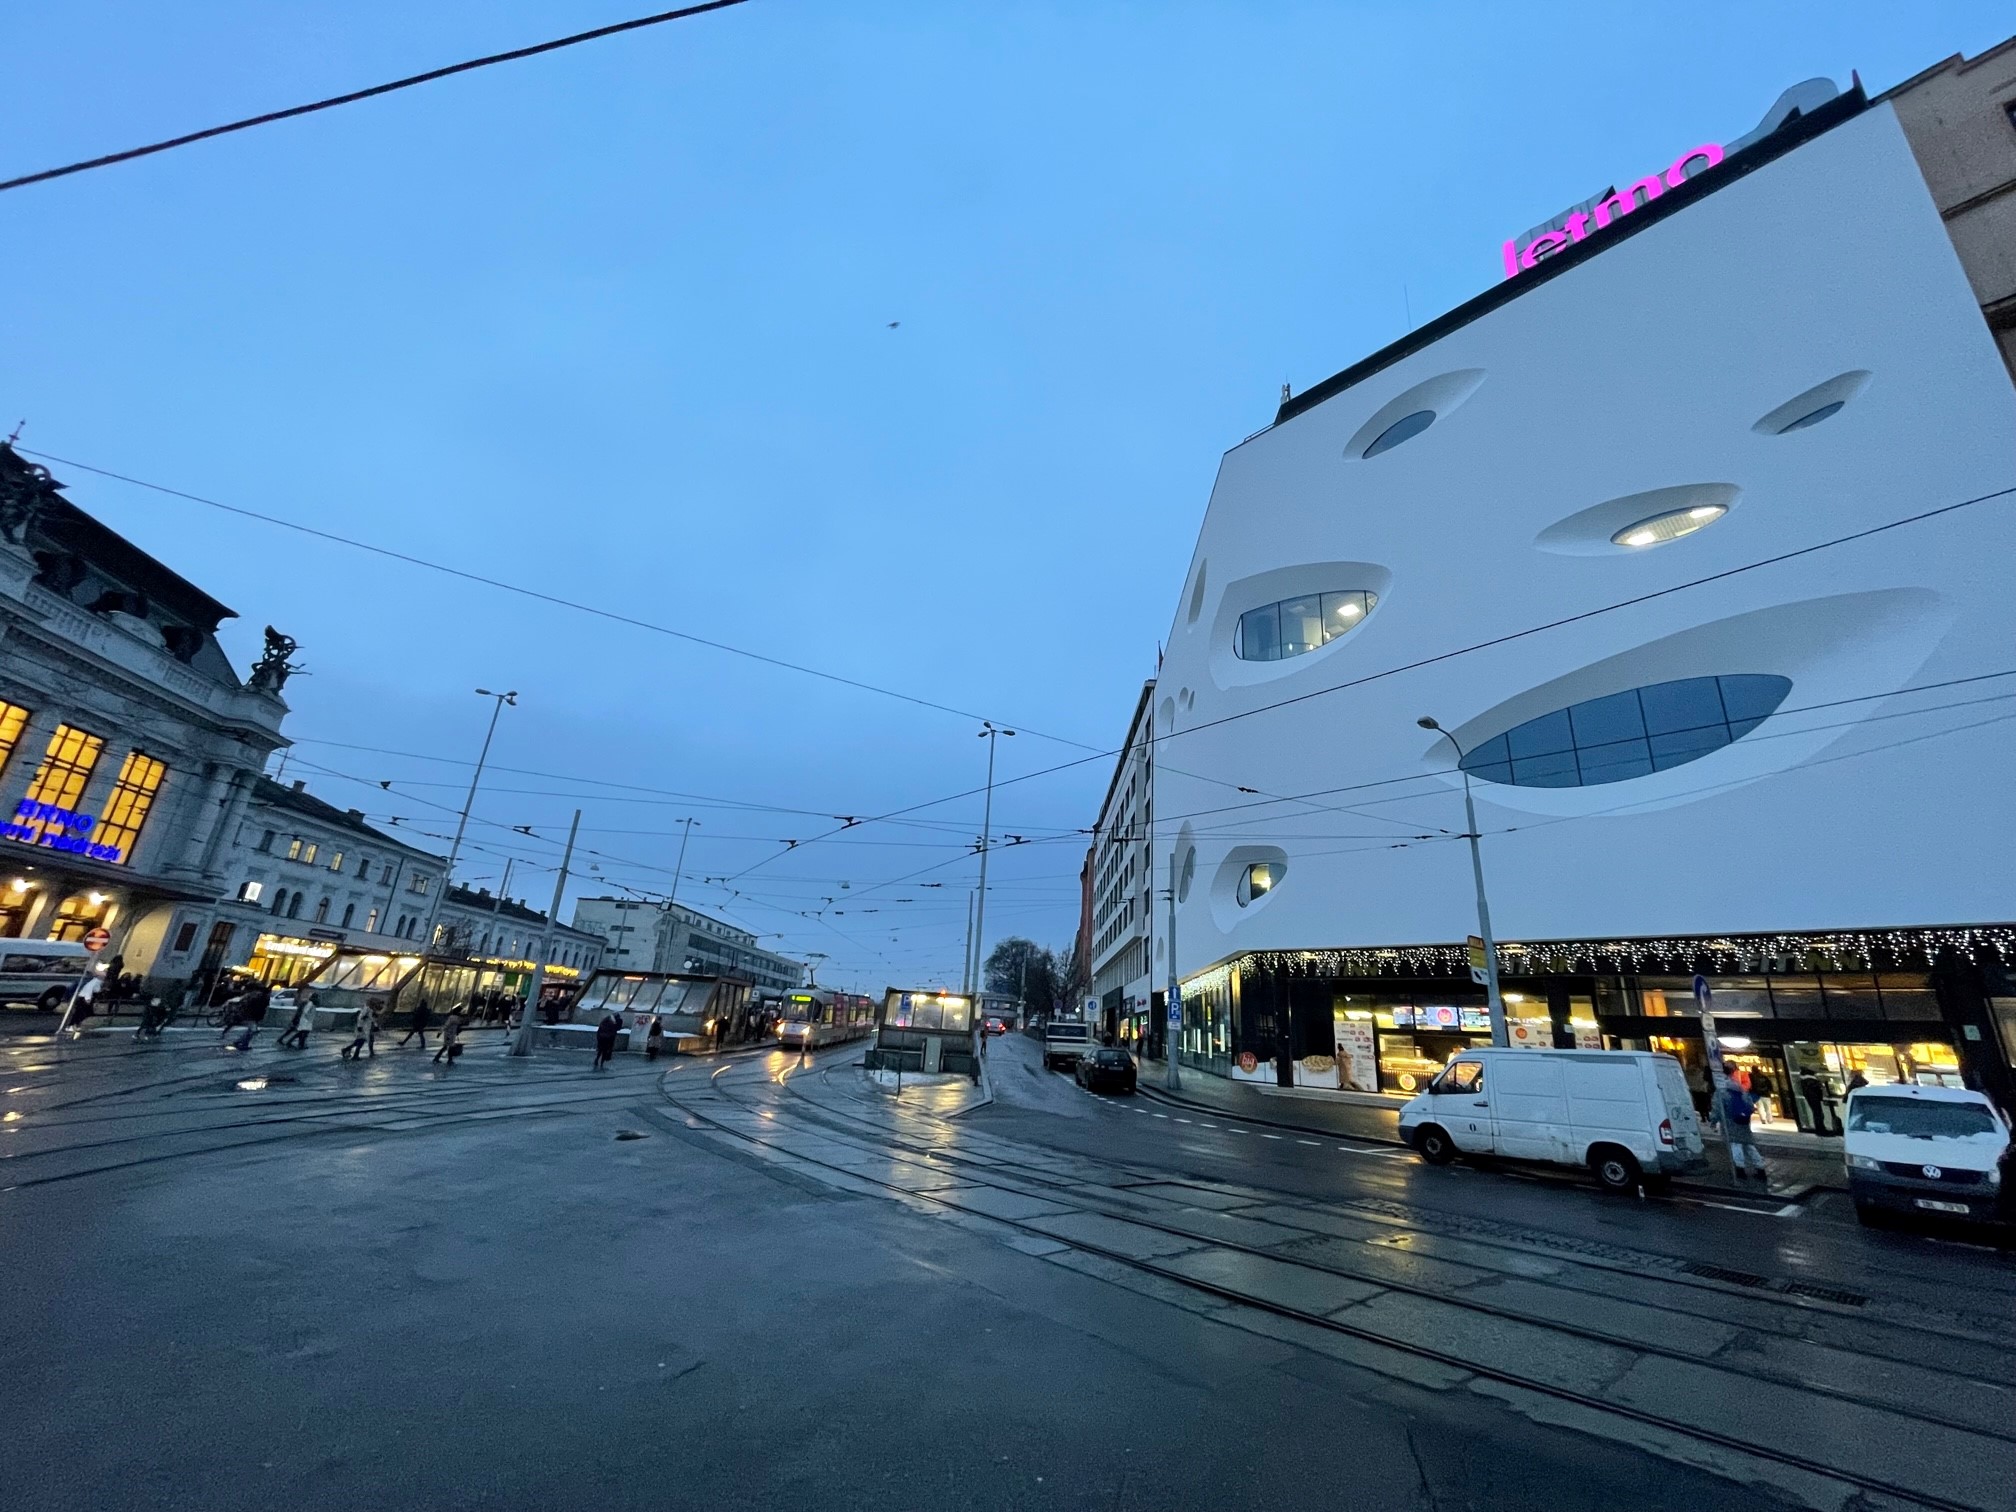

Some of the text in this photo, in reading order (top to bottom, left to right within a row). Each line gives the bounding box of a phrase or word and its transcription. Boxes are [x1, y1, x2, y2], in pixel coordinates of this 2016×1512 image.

[1503, 144, 1724, 279] letmo
[16, 798, 94, 833] BRNO
[1171, 1003, 1179, 1014] P
